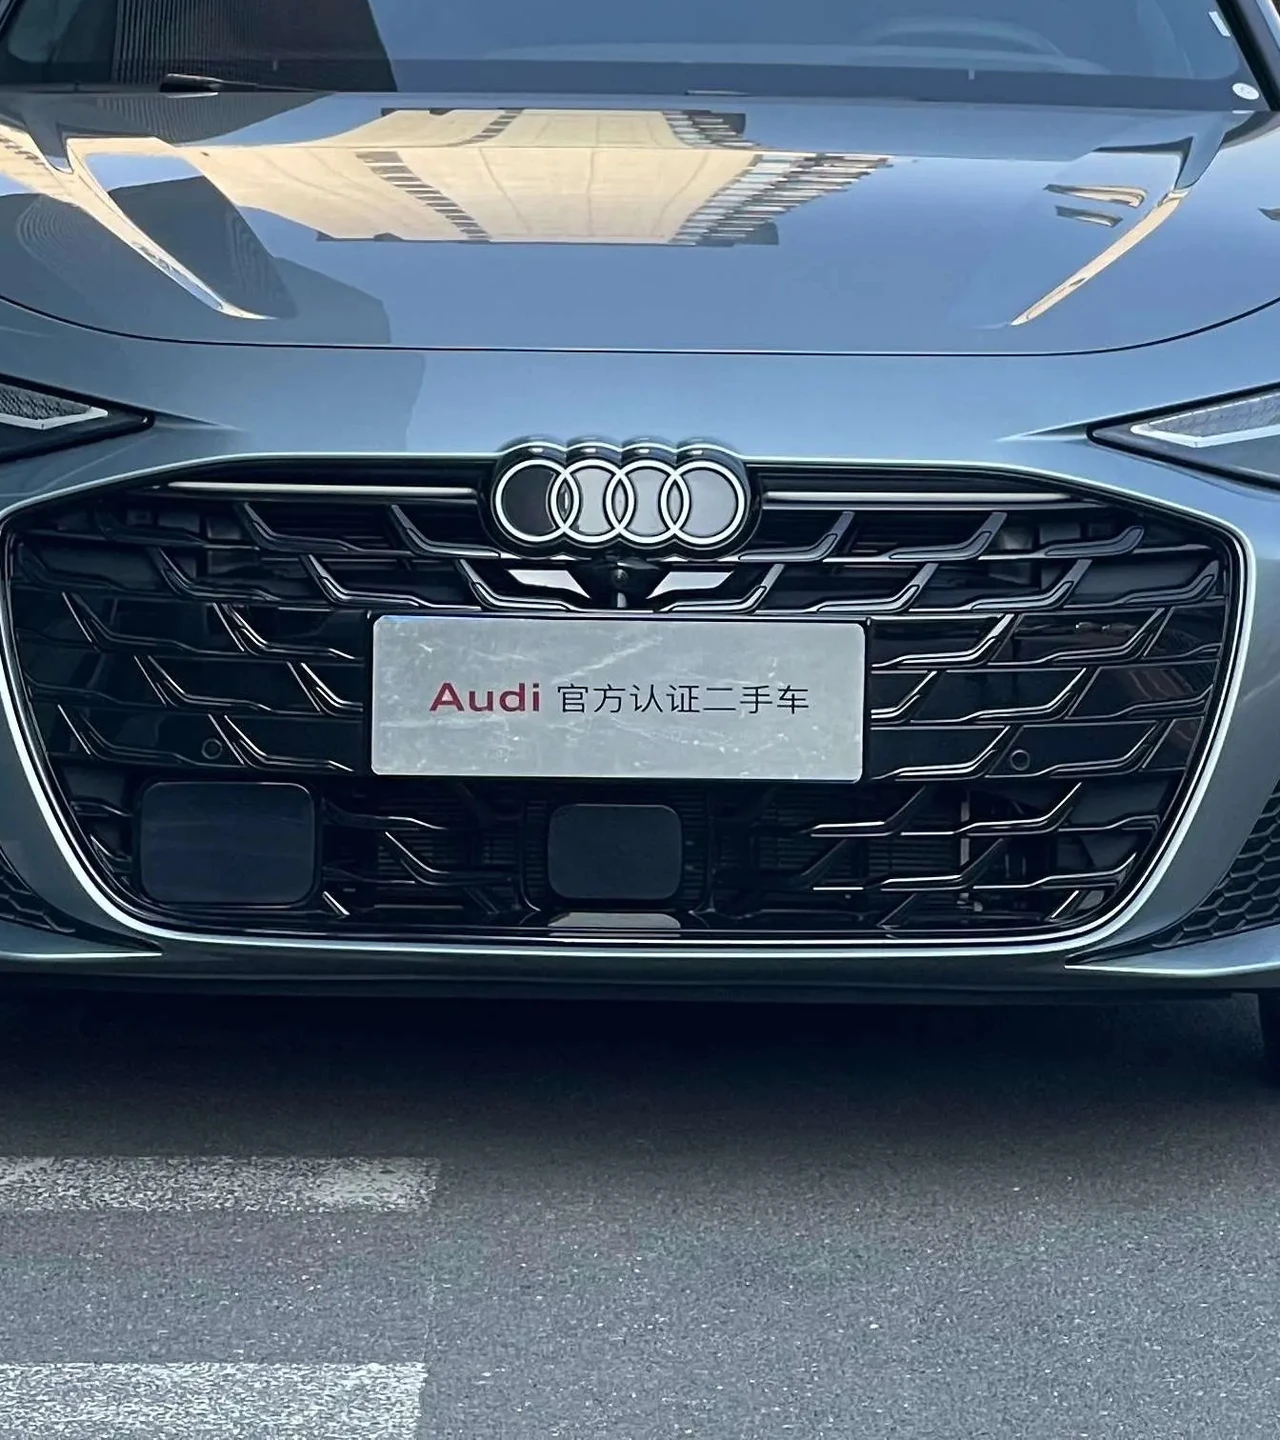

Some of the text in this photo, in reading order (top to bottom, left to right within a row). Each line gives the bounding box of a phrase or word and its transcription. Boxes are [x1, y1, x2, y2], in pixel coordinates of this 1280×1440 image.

[428, 682, 810, 716] Audi 官方认证二手车
